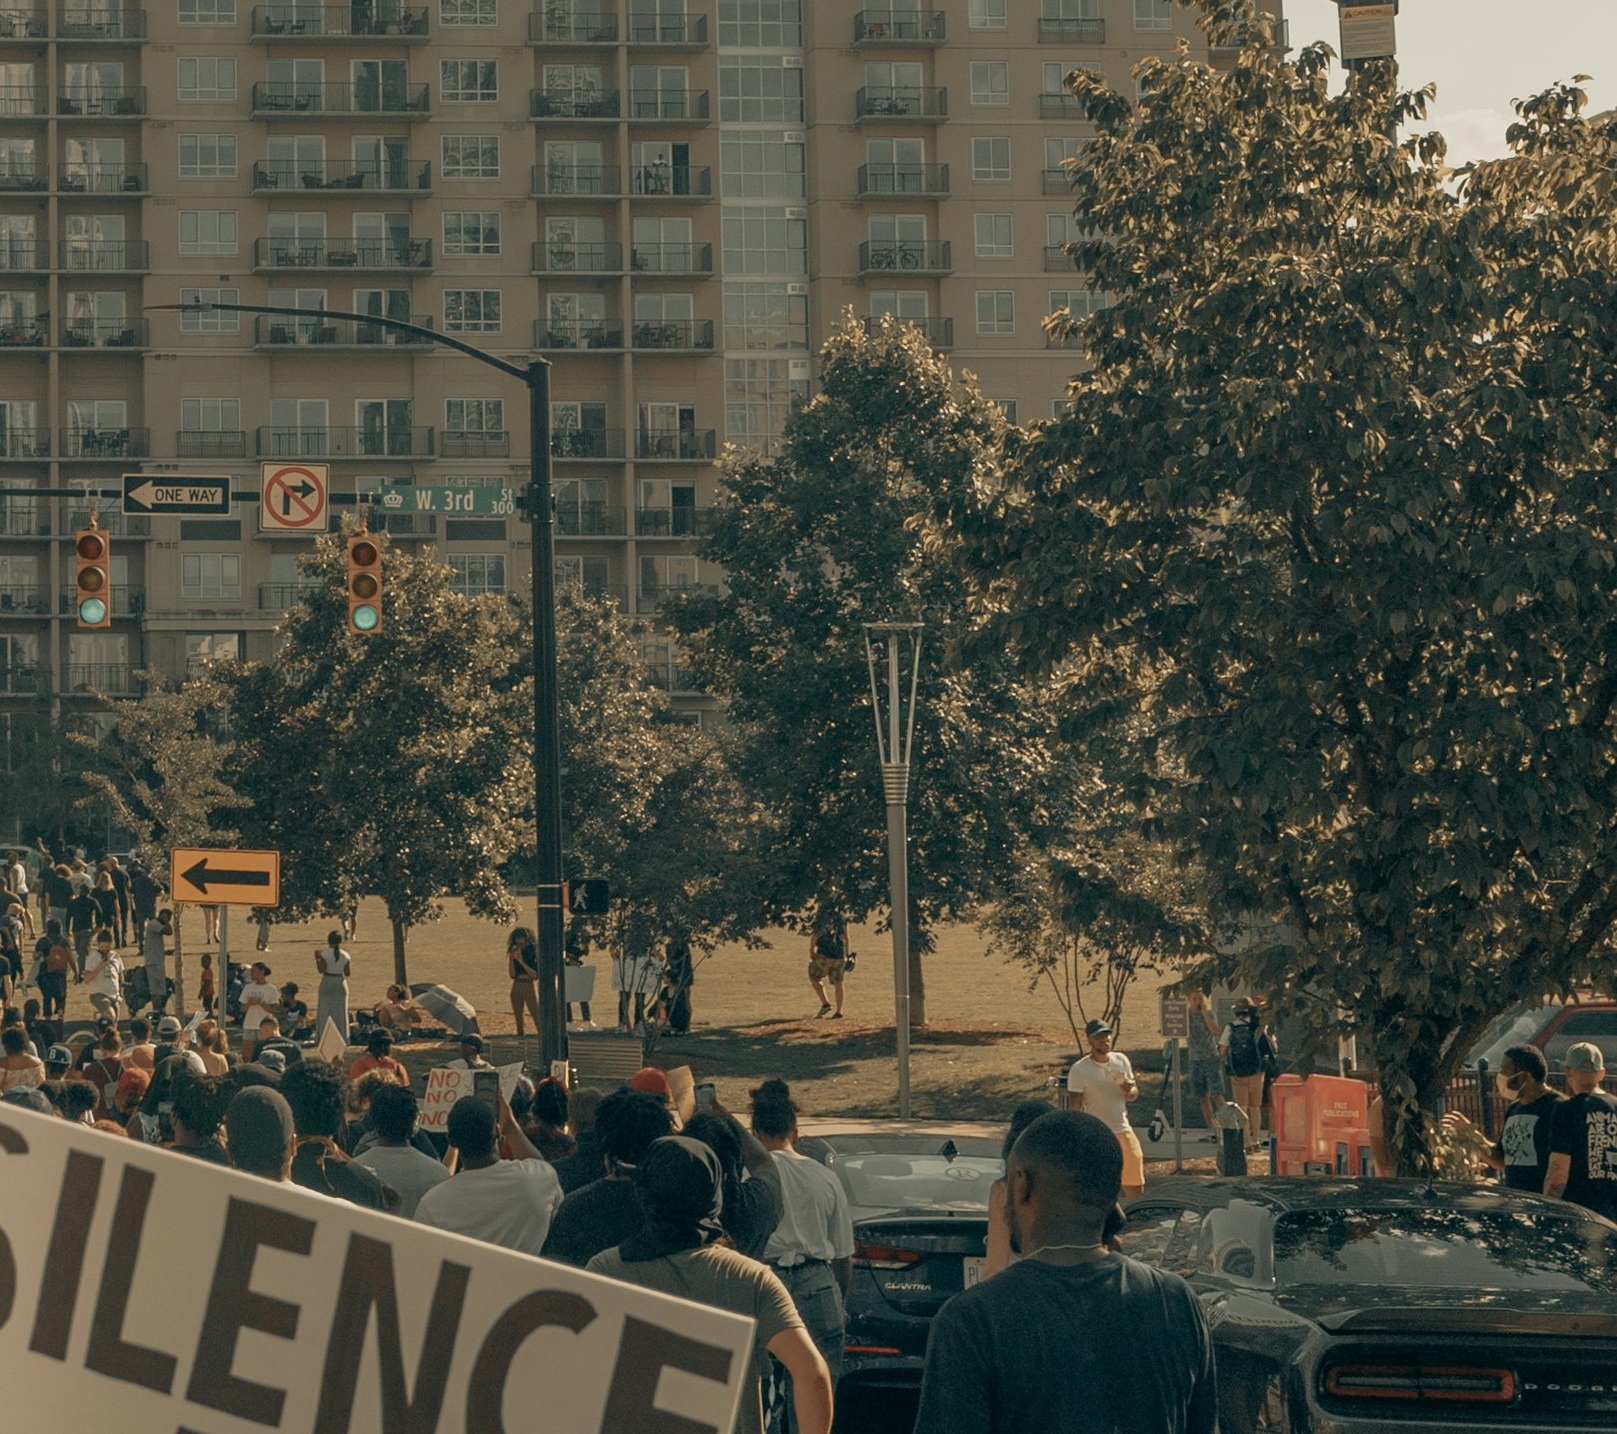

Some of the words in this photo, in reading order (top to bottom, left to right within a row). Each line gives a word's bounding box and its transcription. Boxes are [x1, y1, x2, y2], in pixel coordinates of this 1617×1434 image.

[155, 489, 183, 502] ONE
[189, 489, 218, 502] WAY
[415, 489, 436, 510] W.
[444, 489, 474, 511] 3rd
[501, 488, 513, 501] St
[491, 501, 514, 515] 300
[429, 1071, 460, 1088] NO
[426, 1089, 457, 1103] NO
[421, 1111, 448, 1126] NO
[884, 1282, 932, 1291] ELANTRA
